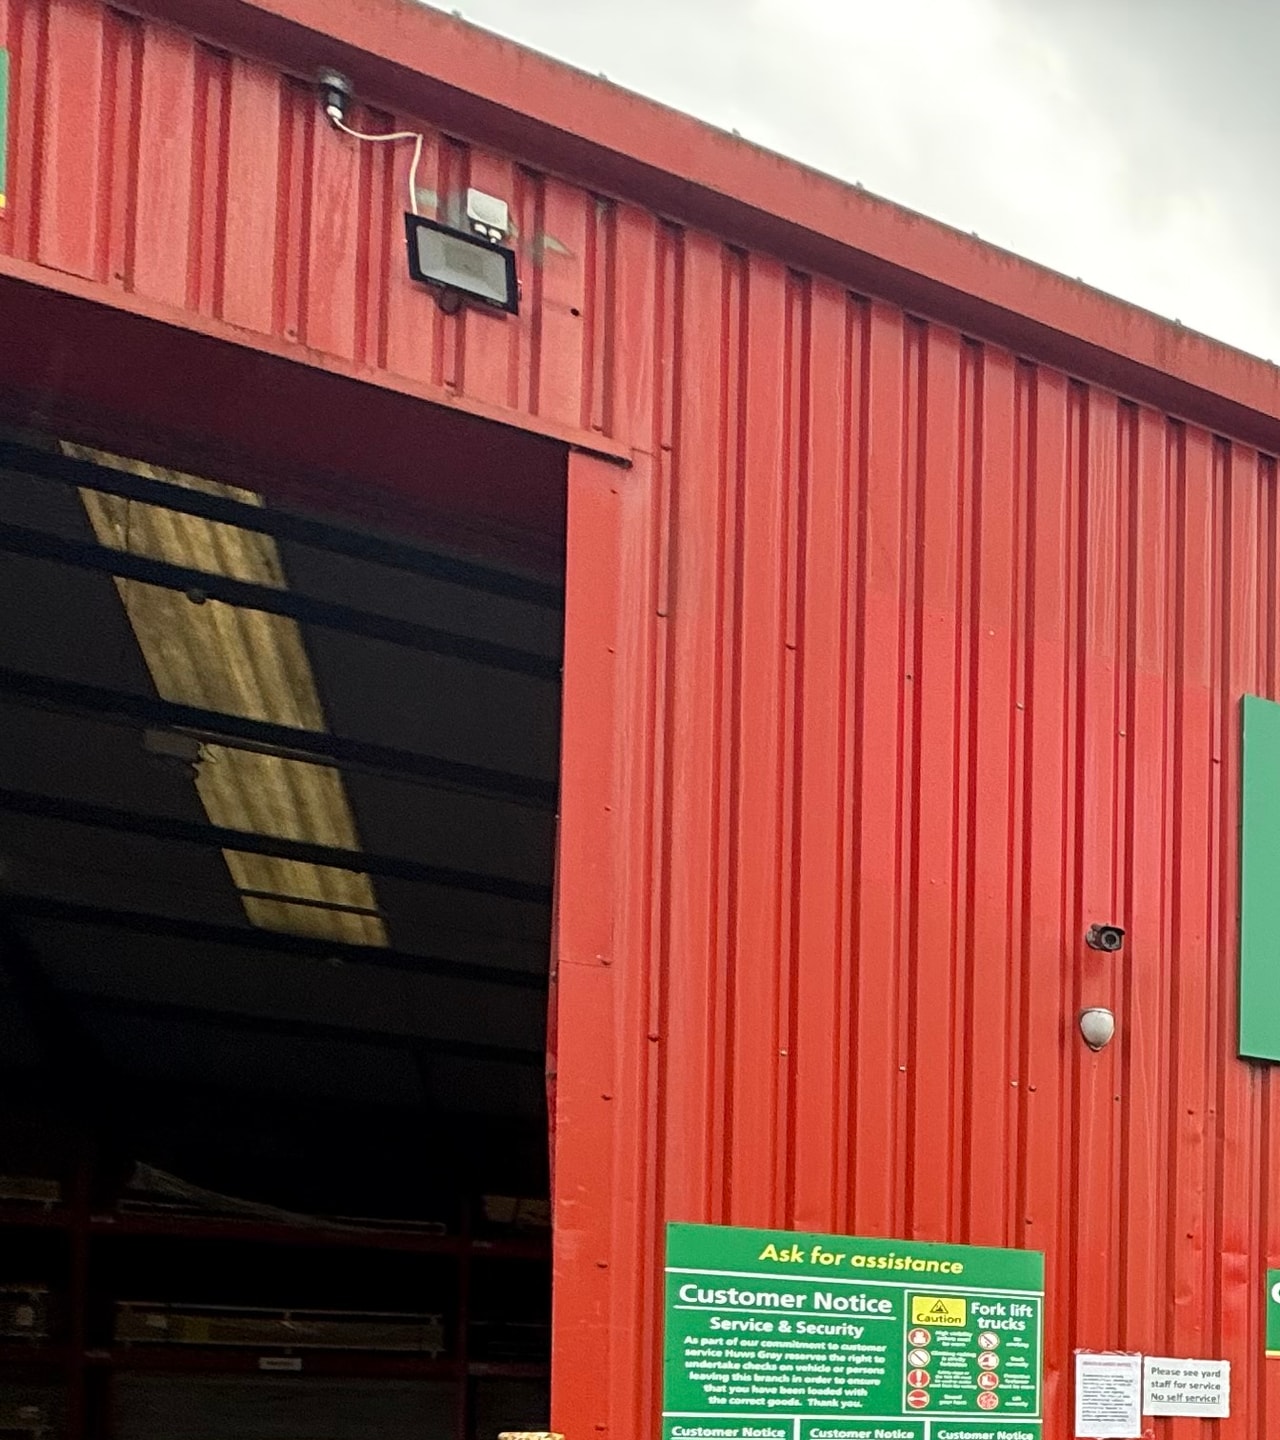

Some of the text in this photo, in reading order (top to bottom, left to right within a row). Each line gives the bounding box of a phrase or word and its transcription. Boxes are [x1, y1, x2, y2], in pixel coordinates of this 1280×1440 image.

[758, 1243, 963, 1275] Ask for assistance
[678, 1284, 893, 1314] Customer Notice
[971, 1302, 1033, 1317] Fork lift
[917, 1313, 961, 1324] Caution
[977, 1318, 1026, 1330] trucks
[709, 1316, 864, 1339] Service & Security
[684, 1336, 698, 1344] As
[701, 1338, 724, 1346] part
[726, 1338, 738, 1346] of
[760, 1340, 826, 1350] commitment
[828, 1342, 839, 1350] to
[841, 1344, 887, 1352] customer
[685, 1348, 722, 1357] service
[725, 1350, 755, 1358] Huws
[757, 1350, 783, 1361] Gray
[785, 1353, 827, 1361] reserves
[829, 1353, 846, 1361] the
[848, 1354, 872, 1364] right
[685, 1360, 740, 1369] undertake
[742, 1362, 777, 1370] checks
[795, 1364, 831, 1372] vehicle
[846, 1367, 885, 1375] persons
[1151, 1367, 1180, 1376] Please
[1201, 1370, 1221, 1378] yard
[689, 1371, 729, 1383] leaving
[732, 1373, 752, 1381] this
[754, 1374, 790, 1382] branch
[792, 1374, 802, 1383] in
[804, 1376, 832, 1384] order
[703, 1384, 868, 1396] that you have been loaded with
[1151, 1380, 1172, 1389] staff
[1174, 1381, 1186, 1389] for
[708, 1396, 727, 1404] the
[808, 1398, 838, 1407] Thank
[840, 1400, 863, 1409] you.
[1151, 1392, 1220, 1403] No self service!
[671, 1426, 786, 1438] Customer Notice
[810, 1428, 914, 1439] Customer Notice
[938, 1430, 1034, 1440] Customer Notice
